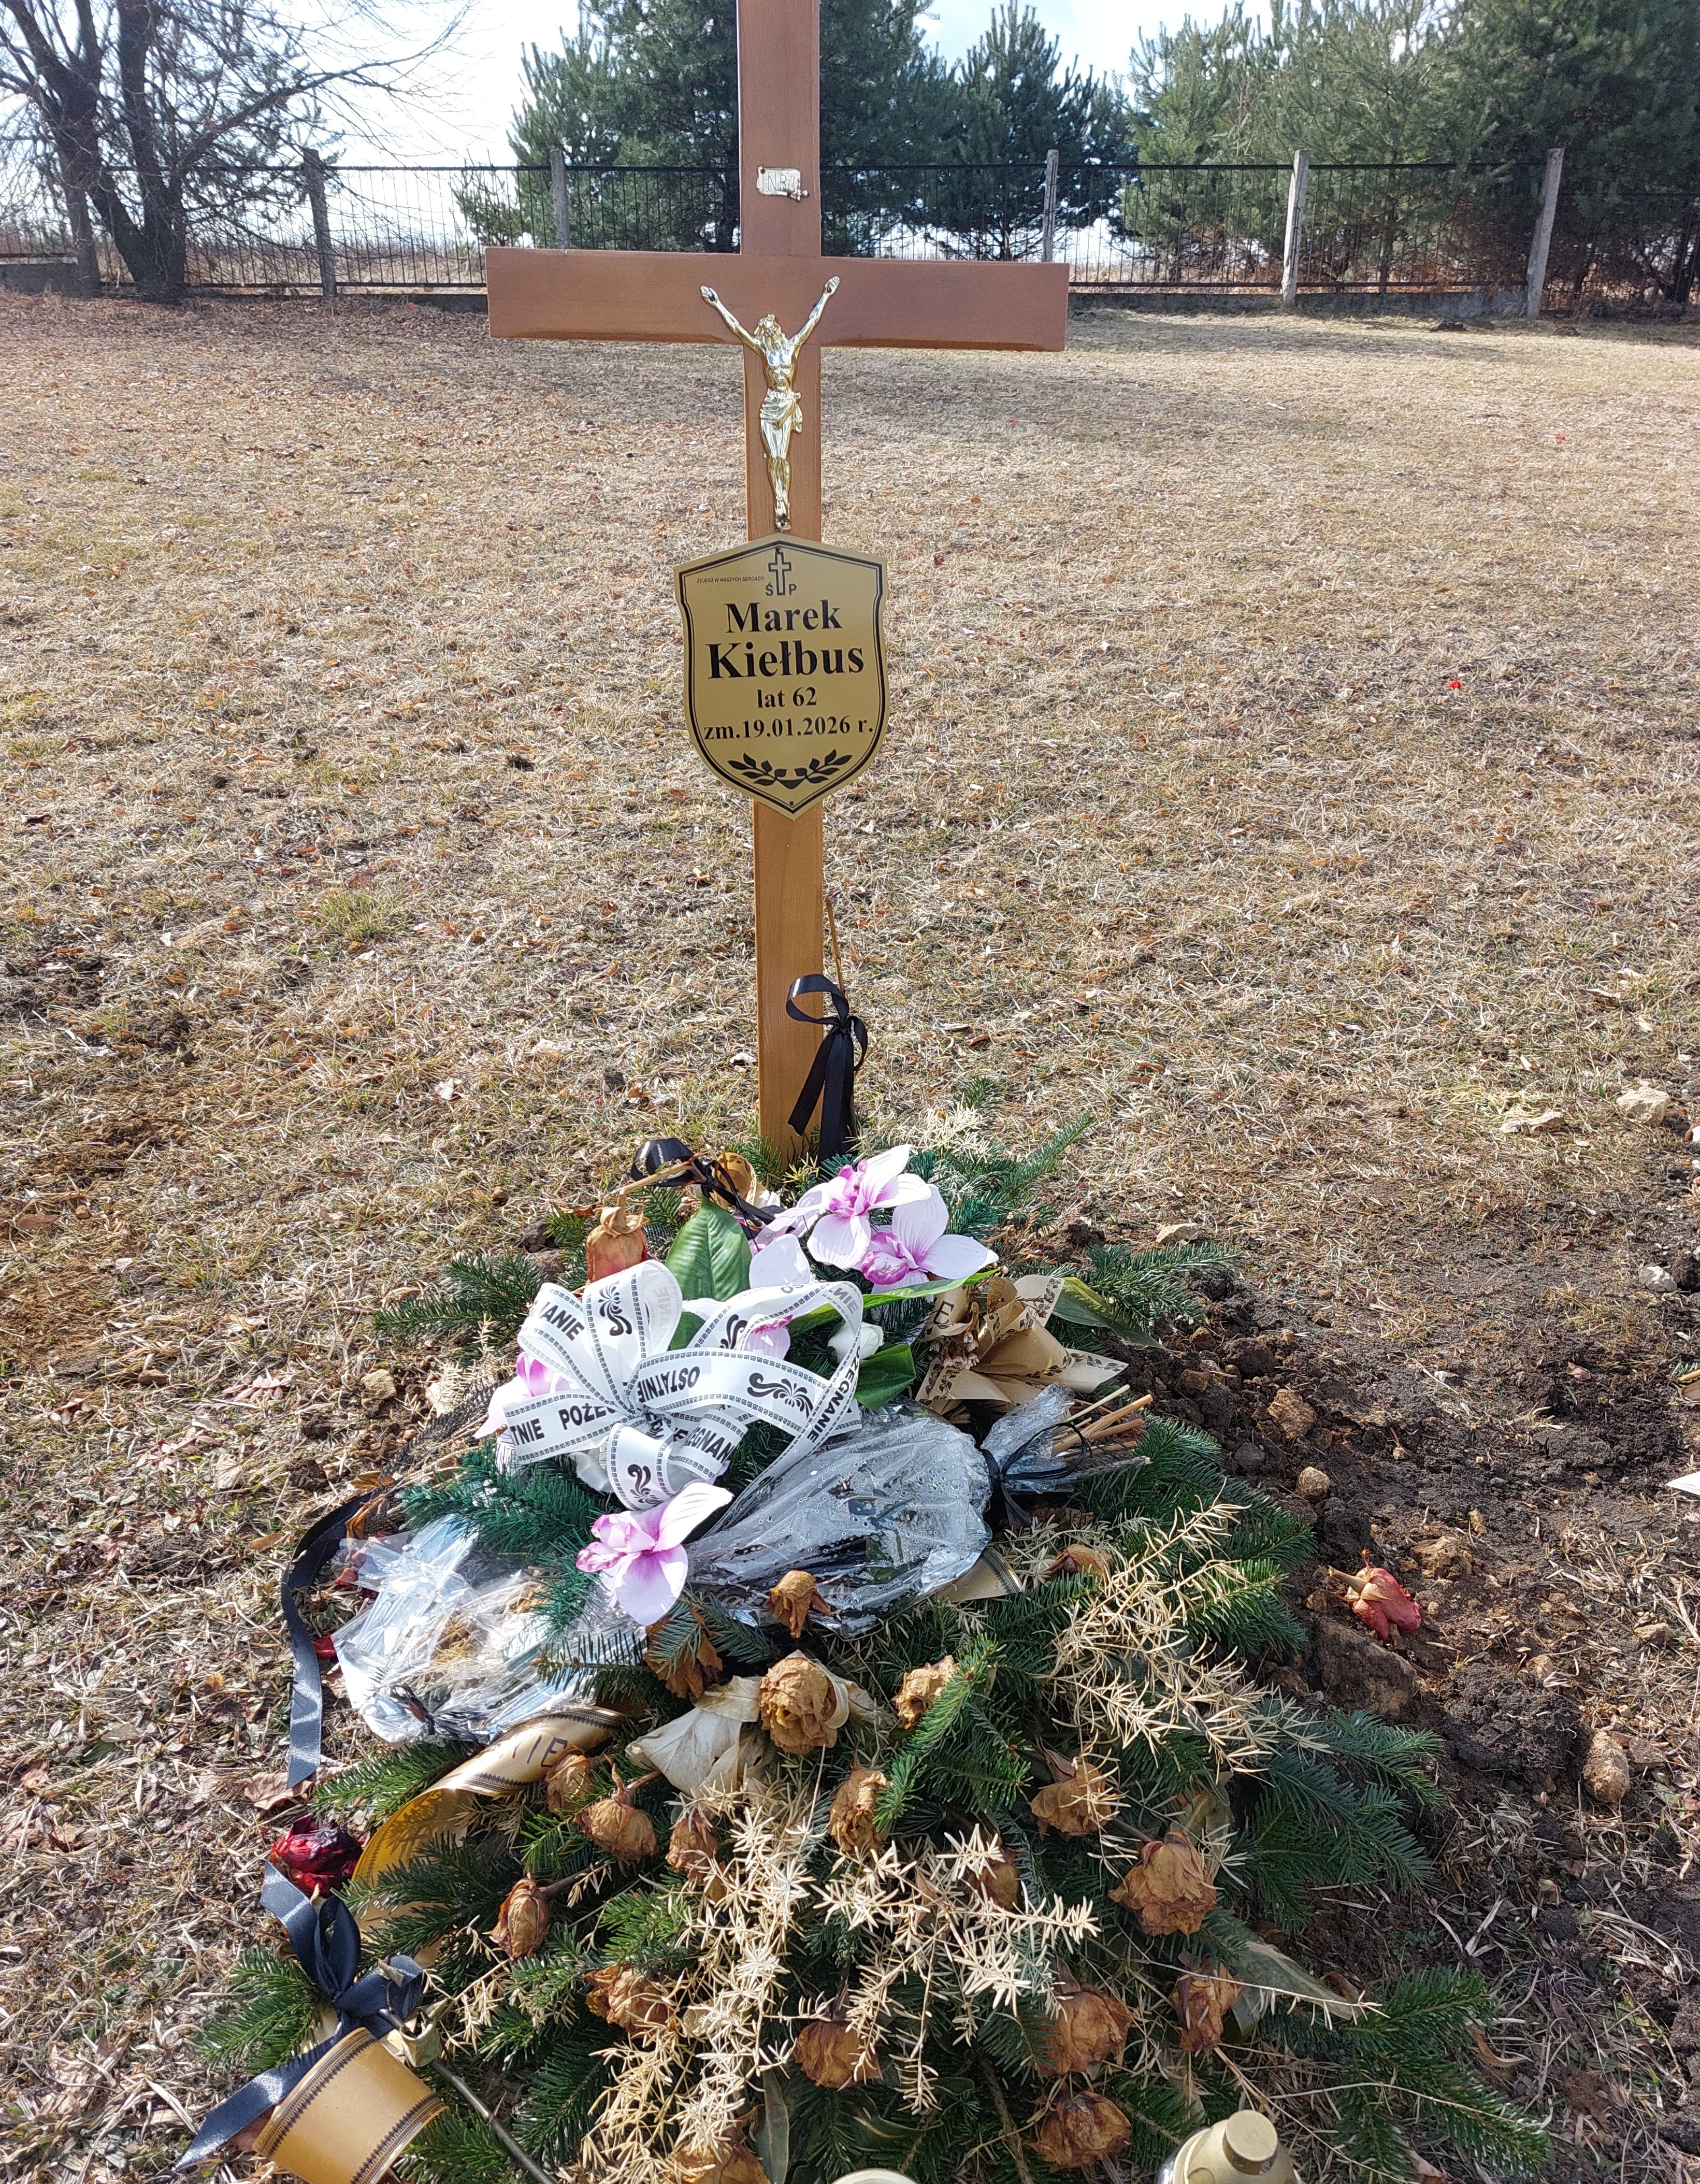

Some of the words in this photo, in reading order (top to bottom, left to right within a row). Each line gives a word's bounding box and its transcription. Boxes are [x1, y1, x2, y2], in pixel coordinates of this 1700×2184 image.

[761, 172, 796, 192] INRI
[765, 582, 774, 596] Ś
[789, 583, 797, 596] P
[723, 599, 843, 634] Marek
[705, 640, 865, 679] Kiełbus
[757, 689, 785, 709] lat
[793, 686, 817, 707] 62
[703, 715, 851, 740] zm.19.01.2026
[857, 717, 874, 733] r.
[636, 1366, 700, 1403] OSTATNIE
